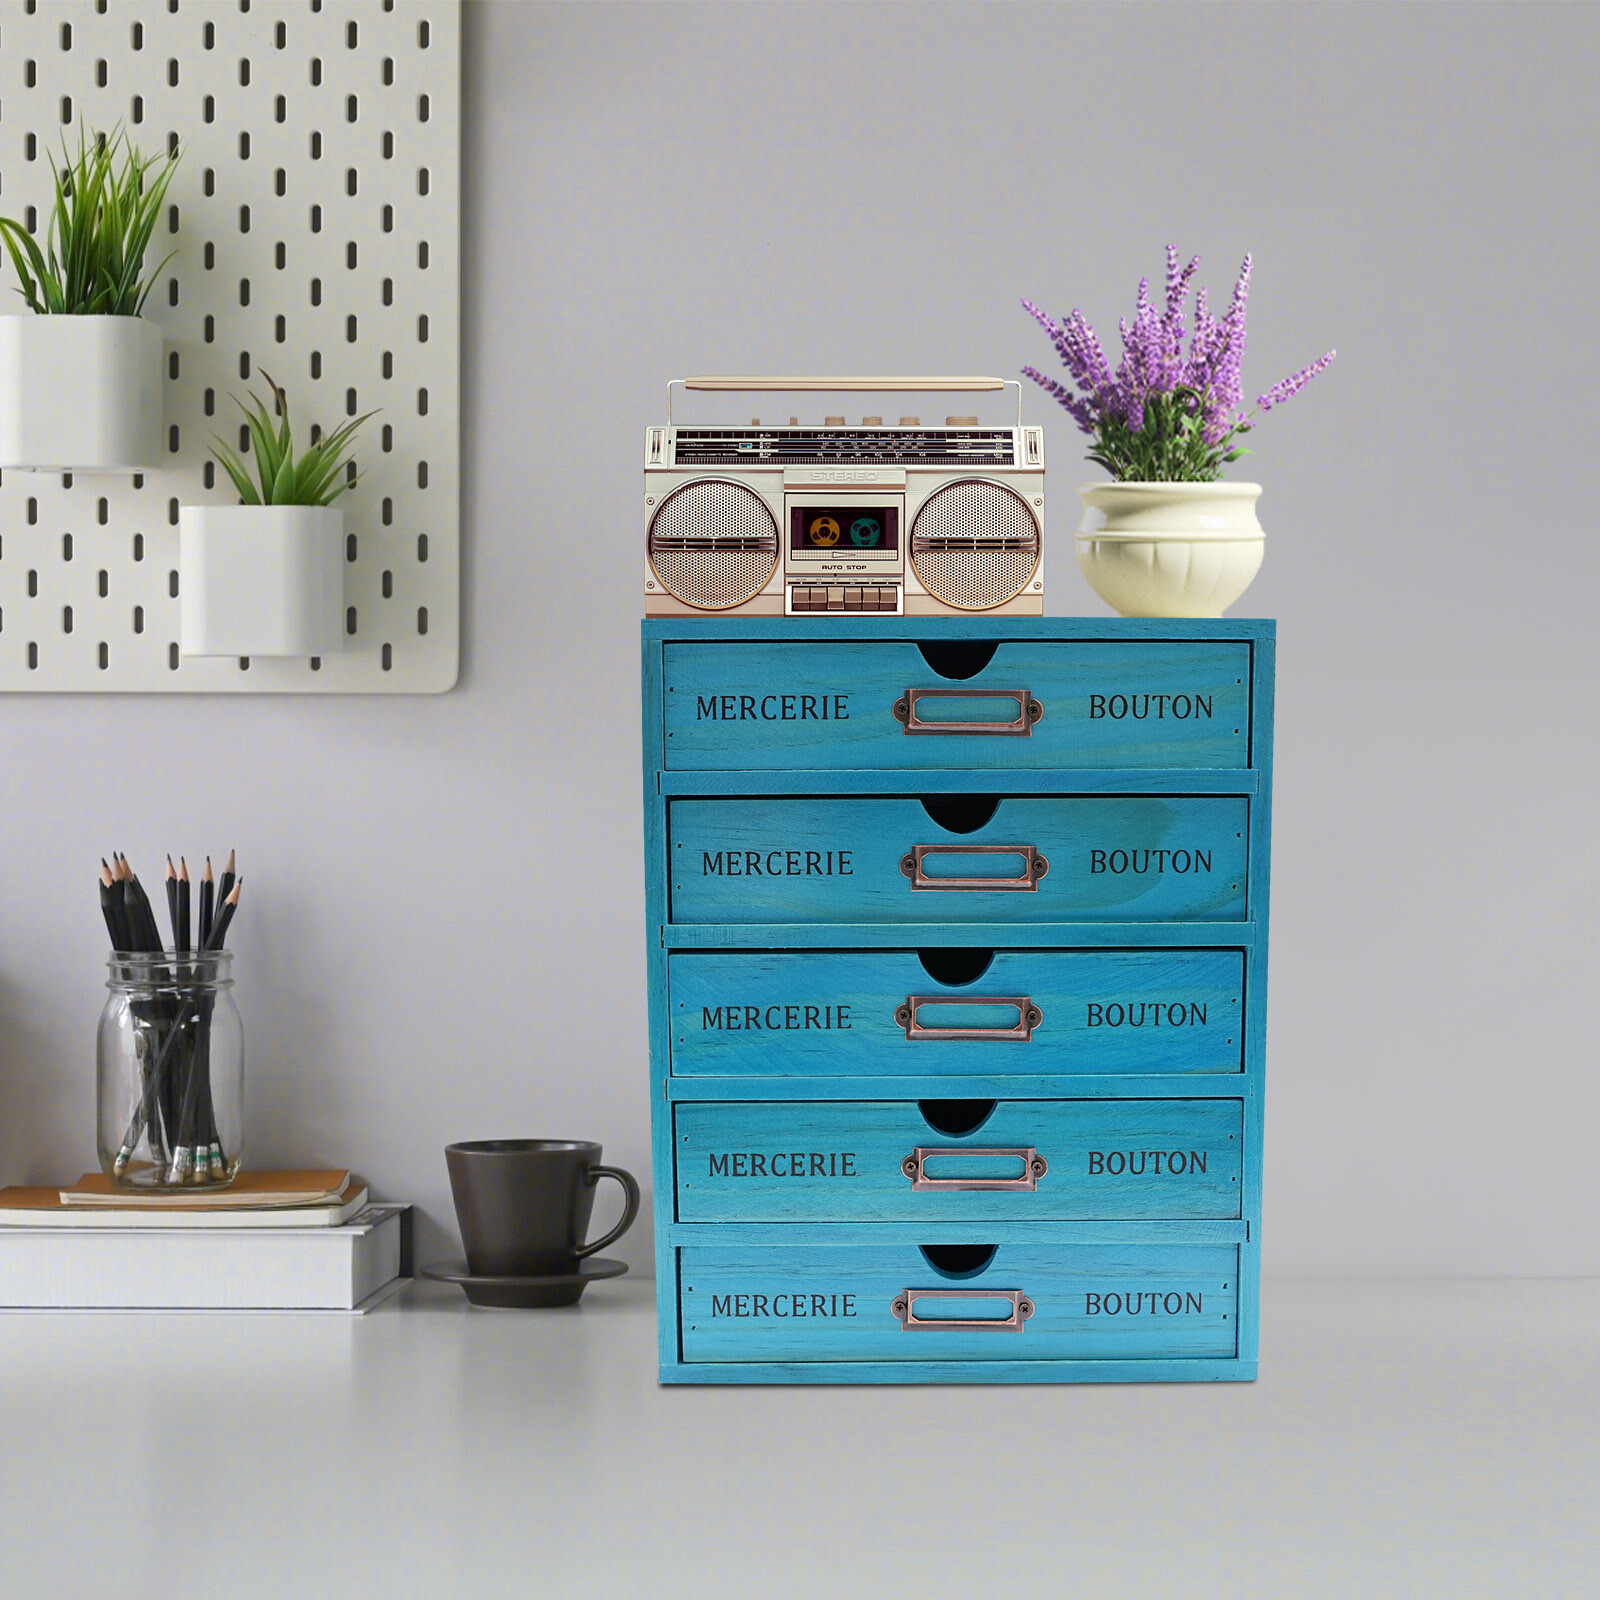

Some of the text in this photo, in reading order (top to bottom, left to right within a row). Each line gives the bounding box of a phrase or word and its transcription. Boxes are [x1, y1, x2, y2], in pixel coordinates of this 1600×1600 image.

[811, 470, 878, 482] STEREO
[697, 693, 850, 720] MERCERIE
[1090, 695, 1213, 719] BOUTON
[703, 851, 853, 875] MERCERIE
[1091, 850, 1211, 874] BOUTON
[703, 1006, 851, 1030] MERCERIE
[1088, 1003, 1206, 1026] BOUTON
[709, 1153, 856, 1176] MERCERIE
[1089, 1151, 1207, 1174] BOUTON
[713, 1295, 857, 1317] MERCERIE
[1086, 1293, 1202, 1314] BOUTON
